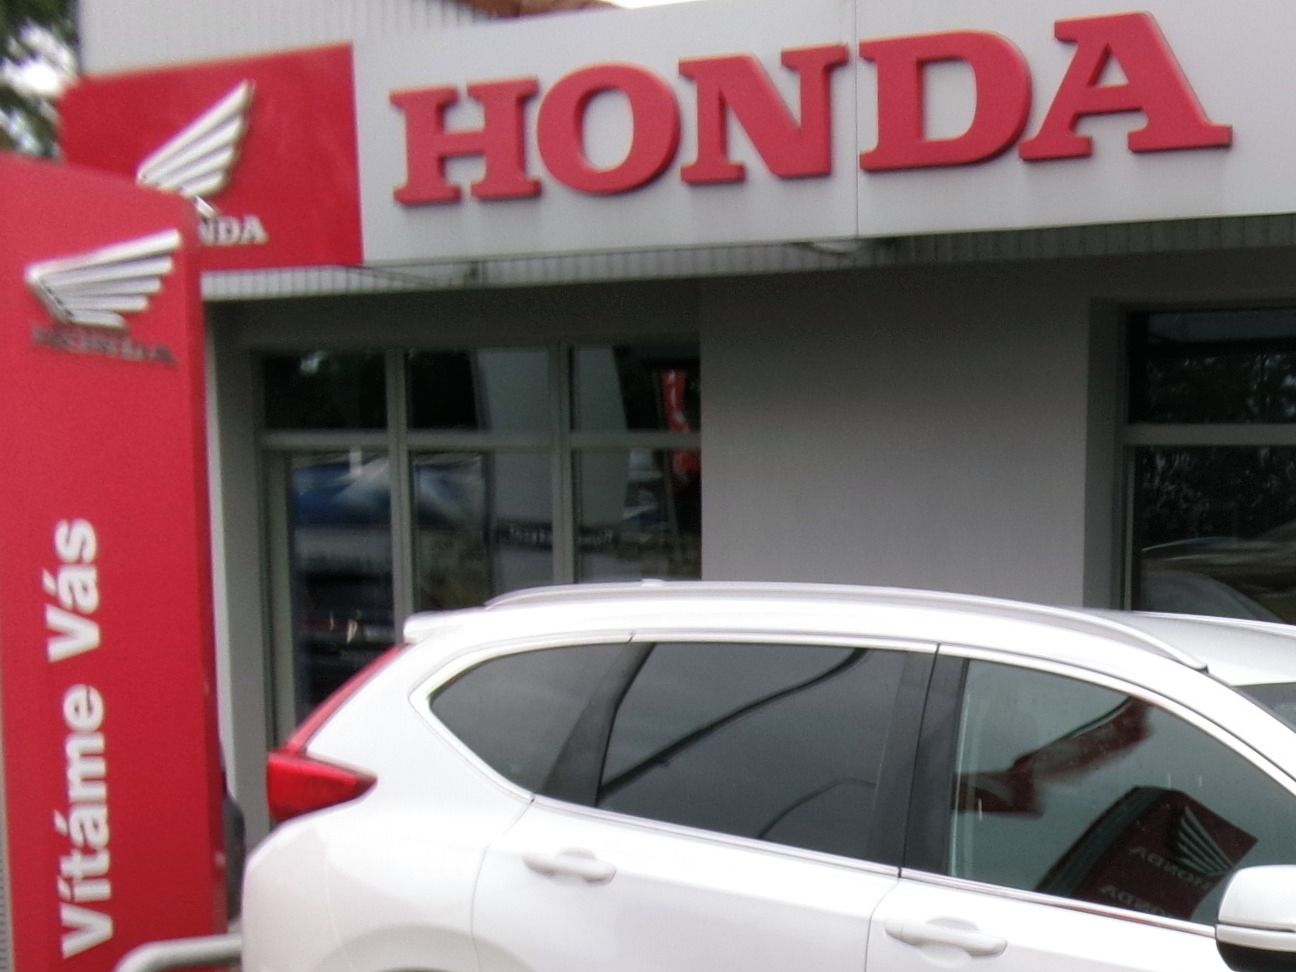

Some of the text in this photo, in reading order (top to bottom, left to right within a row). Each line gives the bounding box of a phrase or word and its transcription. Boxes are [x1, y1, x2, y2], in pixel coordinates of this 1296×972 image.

[389, 10, 1233, 206] HONDA
[198, 214, 268, 246] NDA
[43, 518, 113, 959] Vítáme Vás
